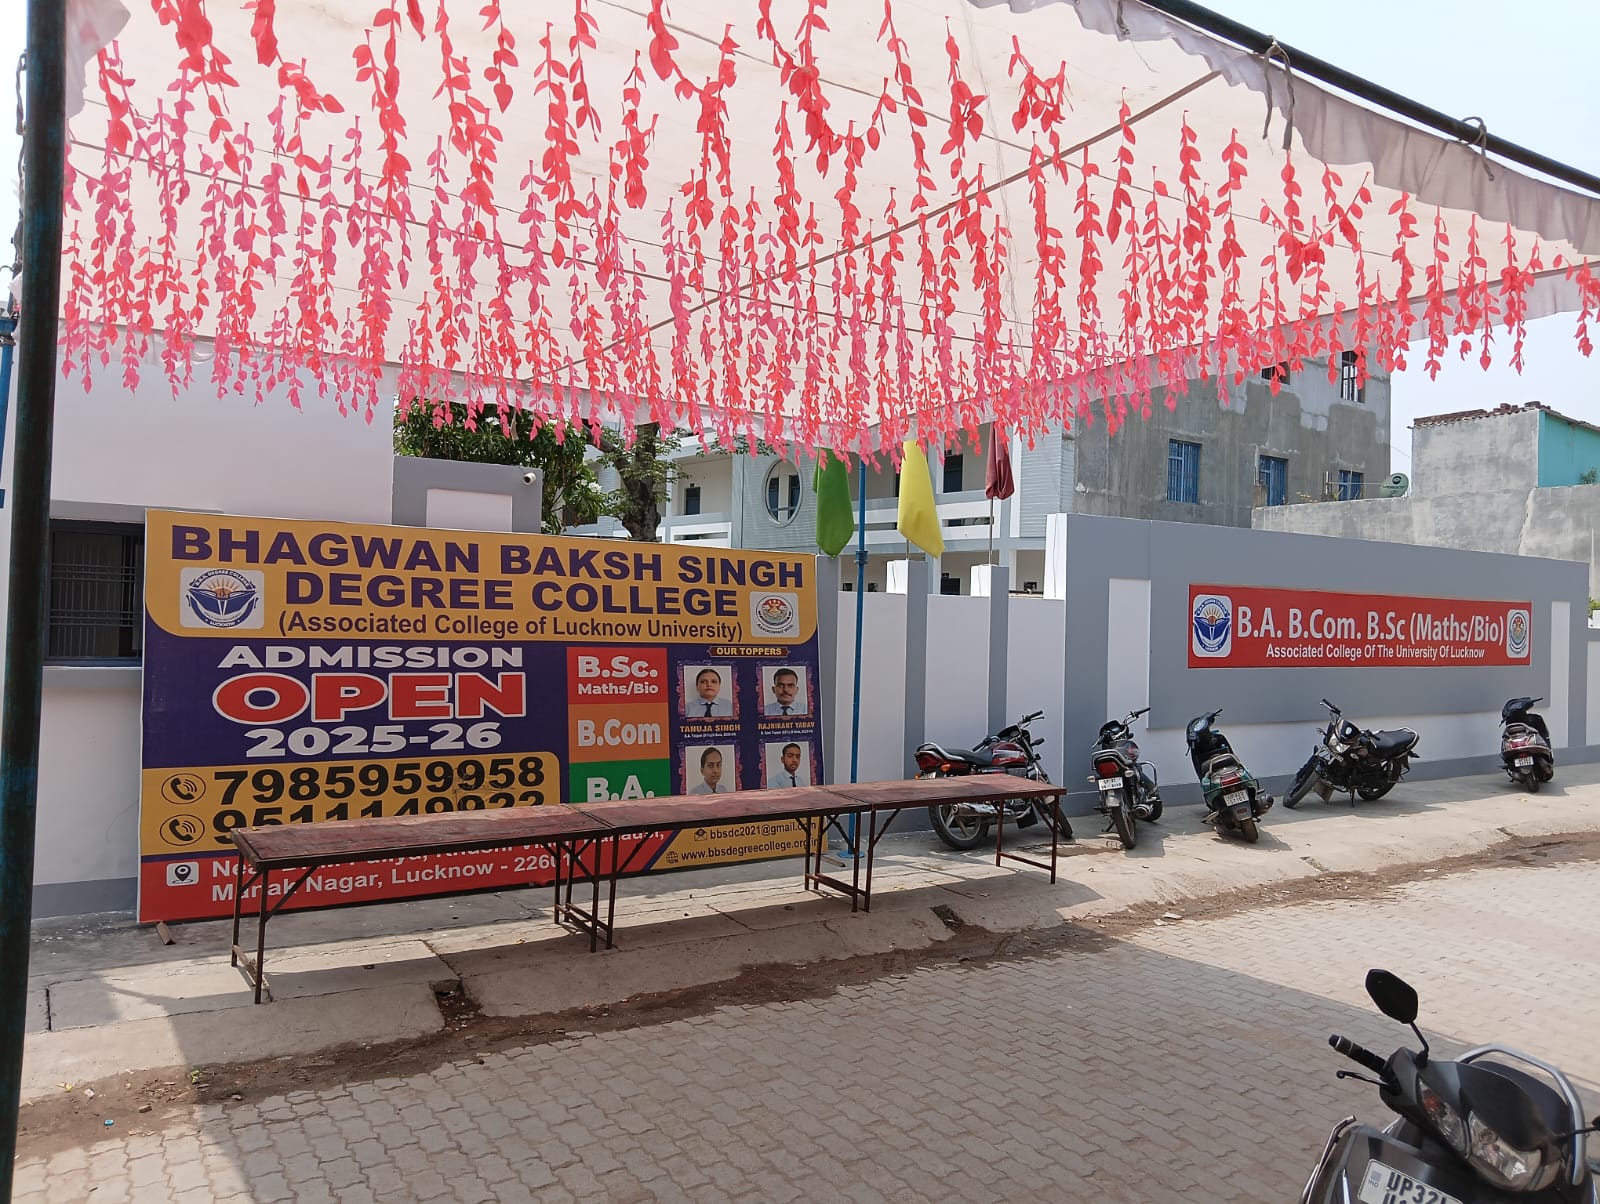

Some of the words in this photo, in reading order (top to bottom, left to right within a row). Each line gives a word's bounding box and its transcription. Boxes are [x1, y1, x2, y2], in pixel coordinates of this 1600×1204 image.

[171, 524, 480, 573] BHAGWAN
[500, 544, 662, 581] BAKSH
[678, 555, 803, 588] SINGH
[285, 571, 514, 610] DEGREE
[532, 580, 738, 617] COLLEGE
[278, 610, 427, 636] (Associated
[434, 614, 519, 638] College
[525, 616, 547, 635] of
[552, 617, 642, 637] Lucknow
[647, 619, 743, 643] University)
[1237, 606, 1282, 638] B.A.
[1288, 608, 1362, 640] B.Com.
[1367, 611, 1406, 641] B.Sc
[1410, 612, 1505, 646] (Maths/Bio)
[217, 645, 523, 669] ADMISSION
[577, 655, 659, 678] B.Sc.
[716, 647, 738, 655] OUR
[740, 647, 782, 656] TOPPERS
[1265, 643, 1324, 658] Associated
[1325, 644, 1362, 661] College
[1364, 644, 1376, 658] Of
[1377, 644, 1394, 658] The
[1396, 645, 1438, 661] University
[1439, 645, 1449, 658] Of
[1450, 646, 1485, 658] Lucknow
[211, 671, 527, 726] OPEN
[577, 682, 659, 696] Maths/Bio
[244, 721, 502, 758] 2025-26
[576, 718, 661, 747] B.Com
[680, 725, 713, 733] TANUJA
[715, 724, 741, 732] SINGH
[214, 756, 545, 806] 7985959958
[586, 774, 656, 802] B.A.
[305, 873, 383, 893] Nagar,
[391, 862, 494, 885] Lucknow
[513, 853, 583, 873] 22601
